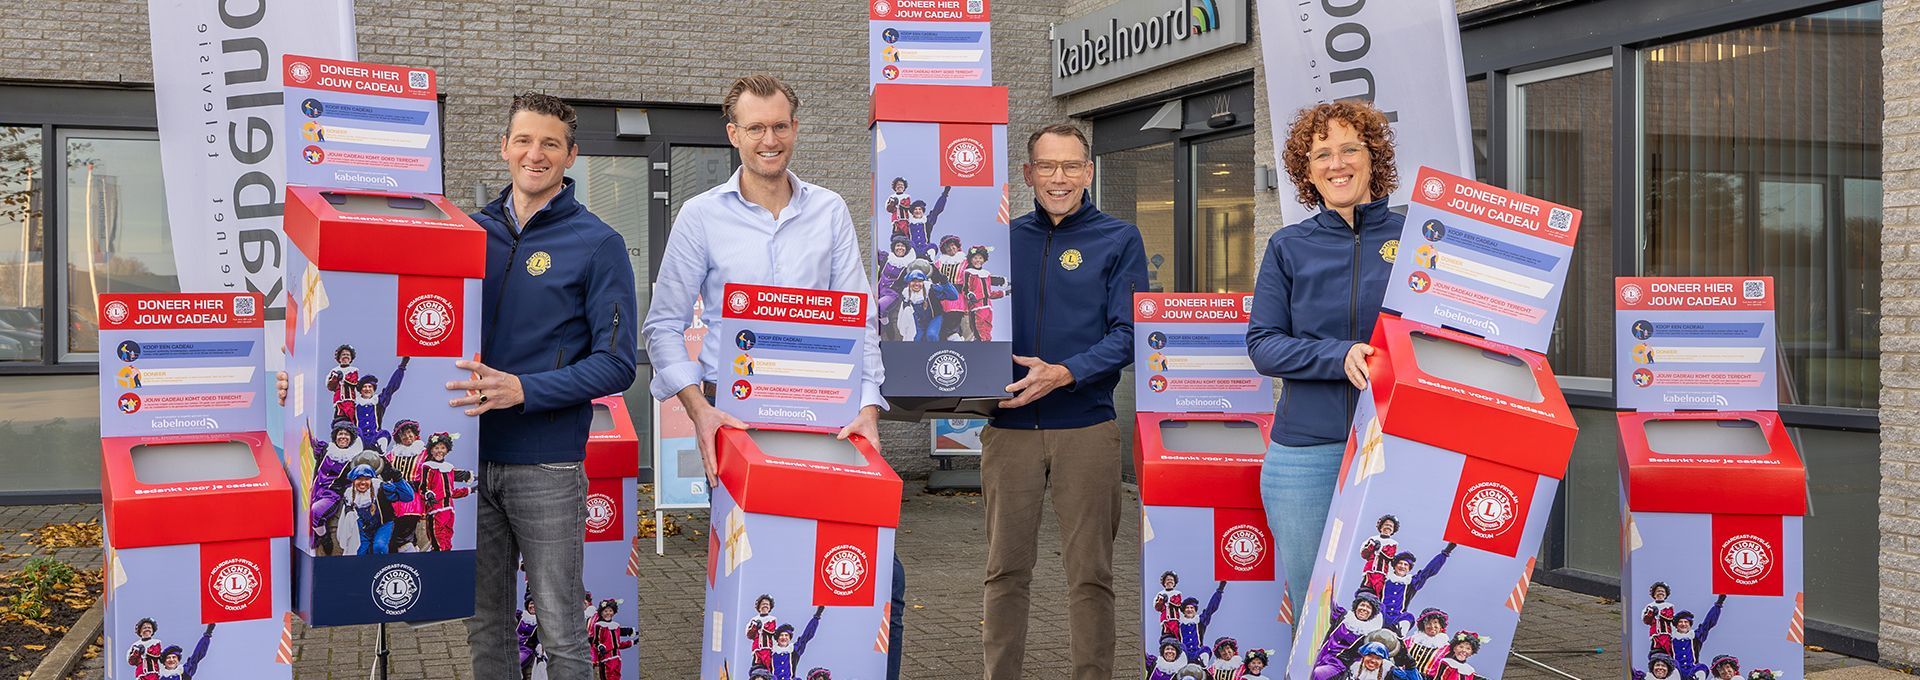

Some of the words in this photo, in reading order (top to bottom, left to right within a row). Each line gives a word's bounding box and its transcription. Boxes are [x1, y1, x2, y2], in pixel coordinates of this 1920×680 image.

[897, 0, 935, 8] DONEER
[895, 10, 922, 18] JOUW
[924, 11, 962, 19] CADEAU
[1058, 0, 1191, 78] kabelnoord
[320, 64, 369, 77] DONEER
[372, 71, 400, 81] HIER
[317, 77, 353, 89] JOUW
[356, 81, 404, 94] CADEAU
[963, 152, 970, 162] L
[335, 172, 386, 184] kabelnoord
[1455, 183, 1507, 206] DONEER
[1510, 199, 1540, 216] HIER
[1447, 197, 1486, 216] JOUW
[1488, 208, 1541, 231] CADEAU
[1651, 283, 1701, 293] DONEER
[1704, 284, 1733, 292] HIER
[138, 300, 191, 310] DONEER
[194, 300, 223, 309] HIER
[757, 292, 803, 304] DONEER
[806, 298, 832, 307] HIER
[1164, 298, 1207, 308] DONEER
[1210, 299, 1235, 307] HIER
[1648, 297, 1684, 306] JOUW
[1687, 296, 1737, 306] CADEAU
[419, 303, 442, 311] LIONS
[134, 315, 173, 324] JOUW
[176, 314, 228, 324] CADEAU
[426, 312, 435, 325] L
[753, 306, 786, 317] JOUW
[789, 308, 834, 321] CADEAU
[1161, 310, 1193, 319] JOUW
[1195, 310, 1238, 319] CADEAU
[1433, 305, 1489, 329] kabelnoord
[944, 364, 951, 375] L
[1175, 398, 1221, 407] kabelnoord
[1417, 378, 1466, 395] Bedankt
[1469, 391, 1495, 403] voor
[1496, 398, 1507, 406] je
[1510, 402, 1555, 418] cadeau!
[1663, 393, 1716, 403] kabelnoord
[758, 407, 806, 418] kabelnoord
[151, 418, 206, 429] kabelnoord
[765, 459, 806, 468] Bedankt
[844, 468, 882, 477] cadeau!
[135, 486, 183, 495] Bedankt
[1480, 491, 1506, 503] LIONS
[594, 508, 602, 517] L
[1484, 502, 1495, 517] L
[1233, 531, 1255, 539] LIONS
[1240, 541, 1249, 552] L
[1735, 542, 1759, 550] LIONS
[1743, 552, 1753, 565] L
[223, 567, 248, 575] LIONS
[841, 562, 850, 575] L
[386, 572, 408, 580] LIONS
[231, 577, 242, 590] L
[393, 582, 402, 594] L
